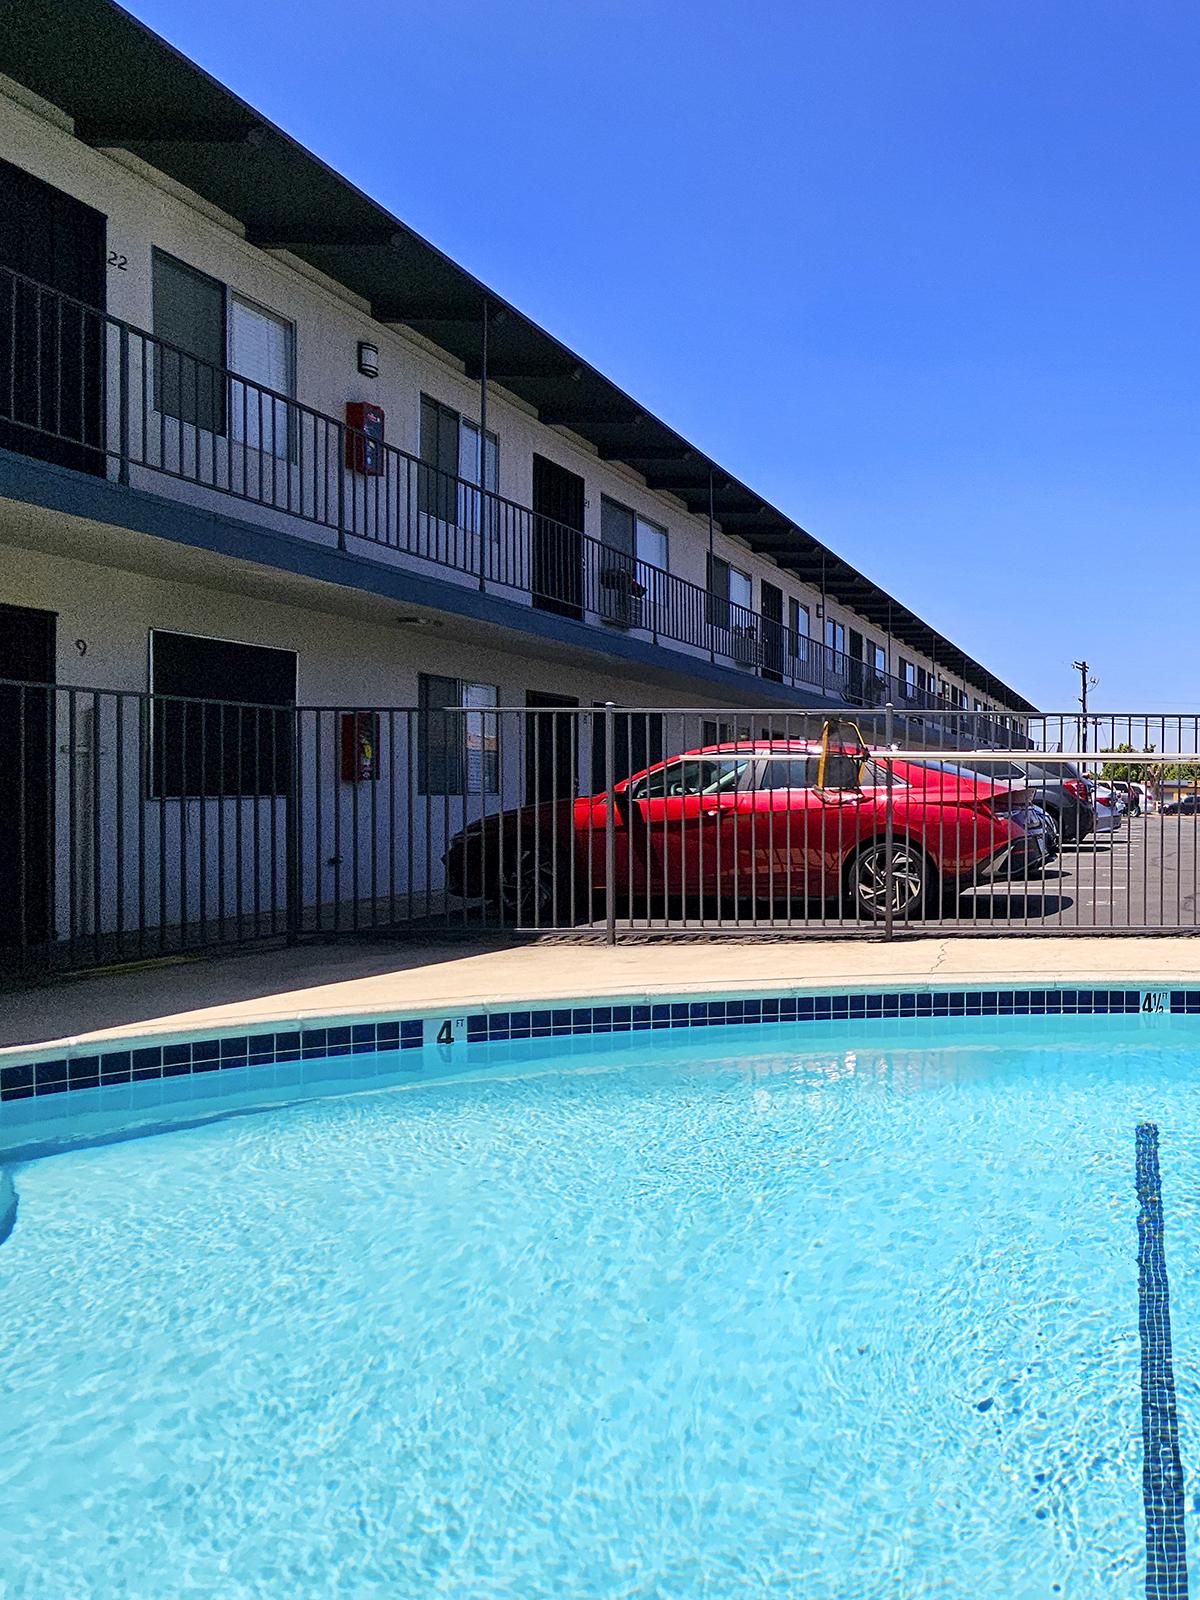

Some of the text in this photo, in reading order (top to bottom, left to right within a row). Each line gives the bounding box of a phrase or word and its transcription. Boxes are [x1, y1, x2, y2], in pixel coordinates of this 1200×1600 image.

[107, 250, 128, 271] 22
[74, 638, 87, 657] 9
[436, 1018, 465, 1044] 4 FT
